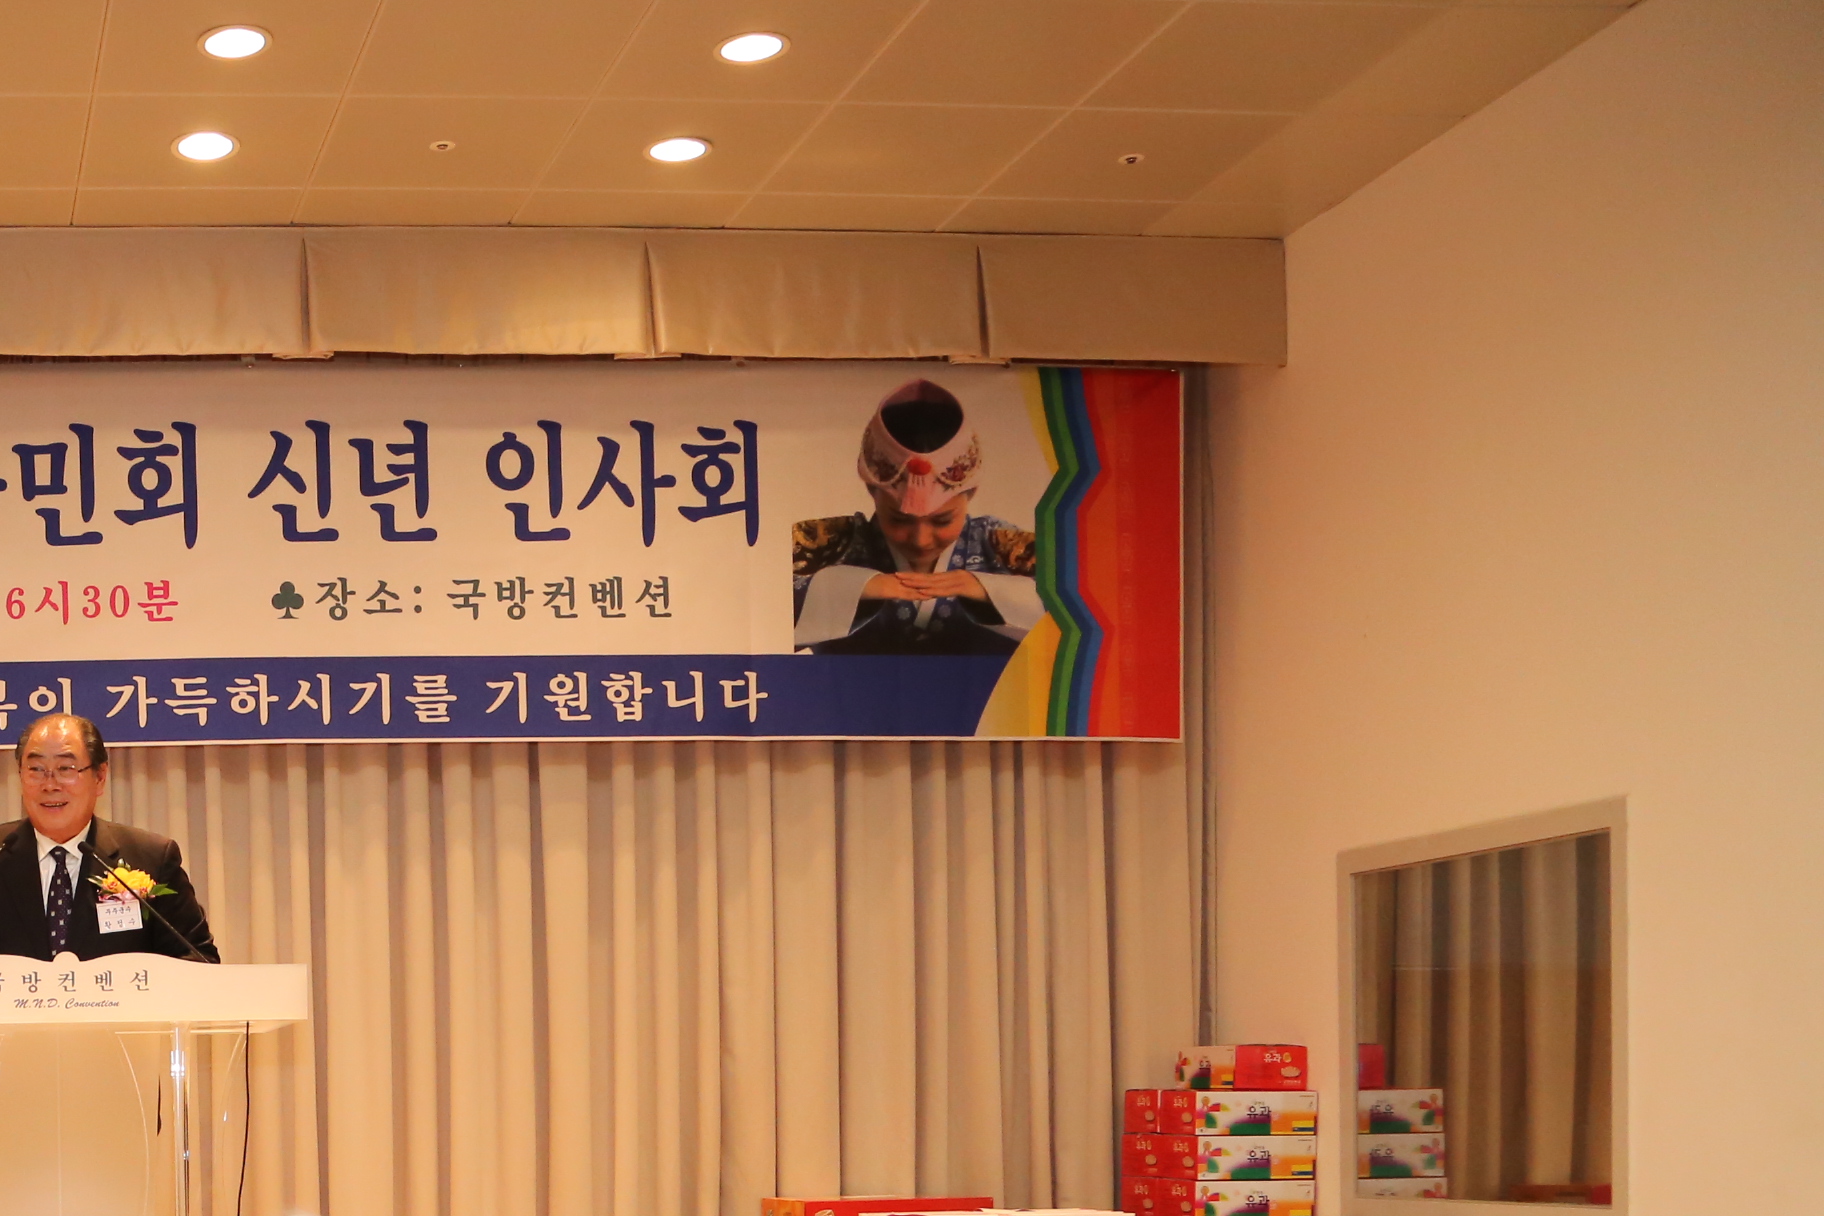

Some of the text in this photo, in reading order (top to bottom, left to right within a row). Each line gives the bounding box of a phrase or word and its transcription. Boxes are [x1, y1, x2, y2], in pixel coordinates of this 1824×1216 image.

[249, 420, 437, 542] 신년
[486, 420, 759, 546] 인사회
[315, 576, 672, 621] 장소: 국방컨벤션
[106, 672, 459, 728] 가득하시기를
[484, 669, 769, 724] 기원합니다
[14, 997, 120, 1010] M.N.D. Convention
[1247, 1105, 1272, 1118] 유과
[1247, 1150, 1272, 1162] 유과
[1245, 1195, 1270, 1207] 유과
